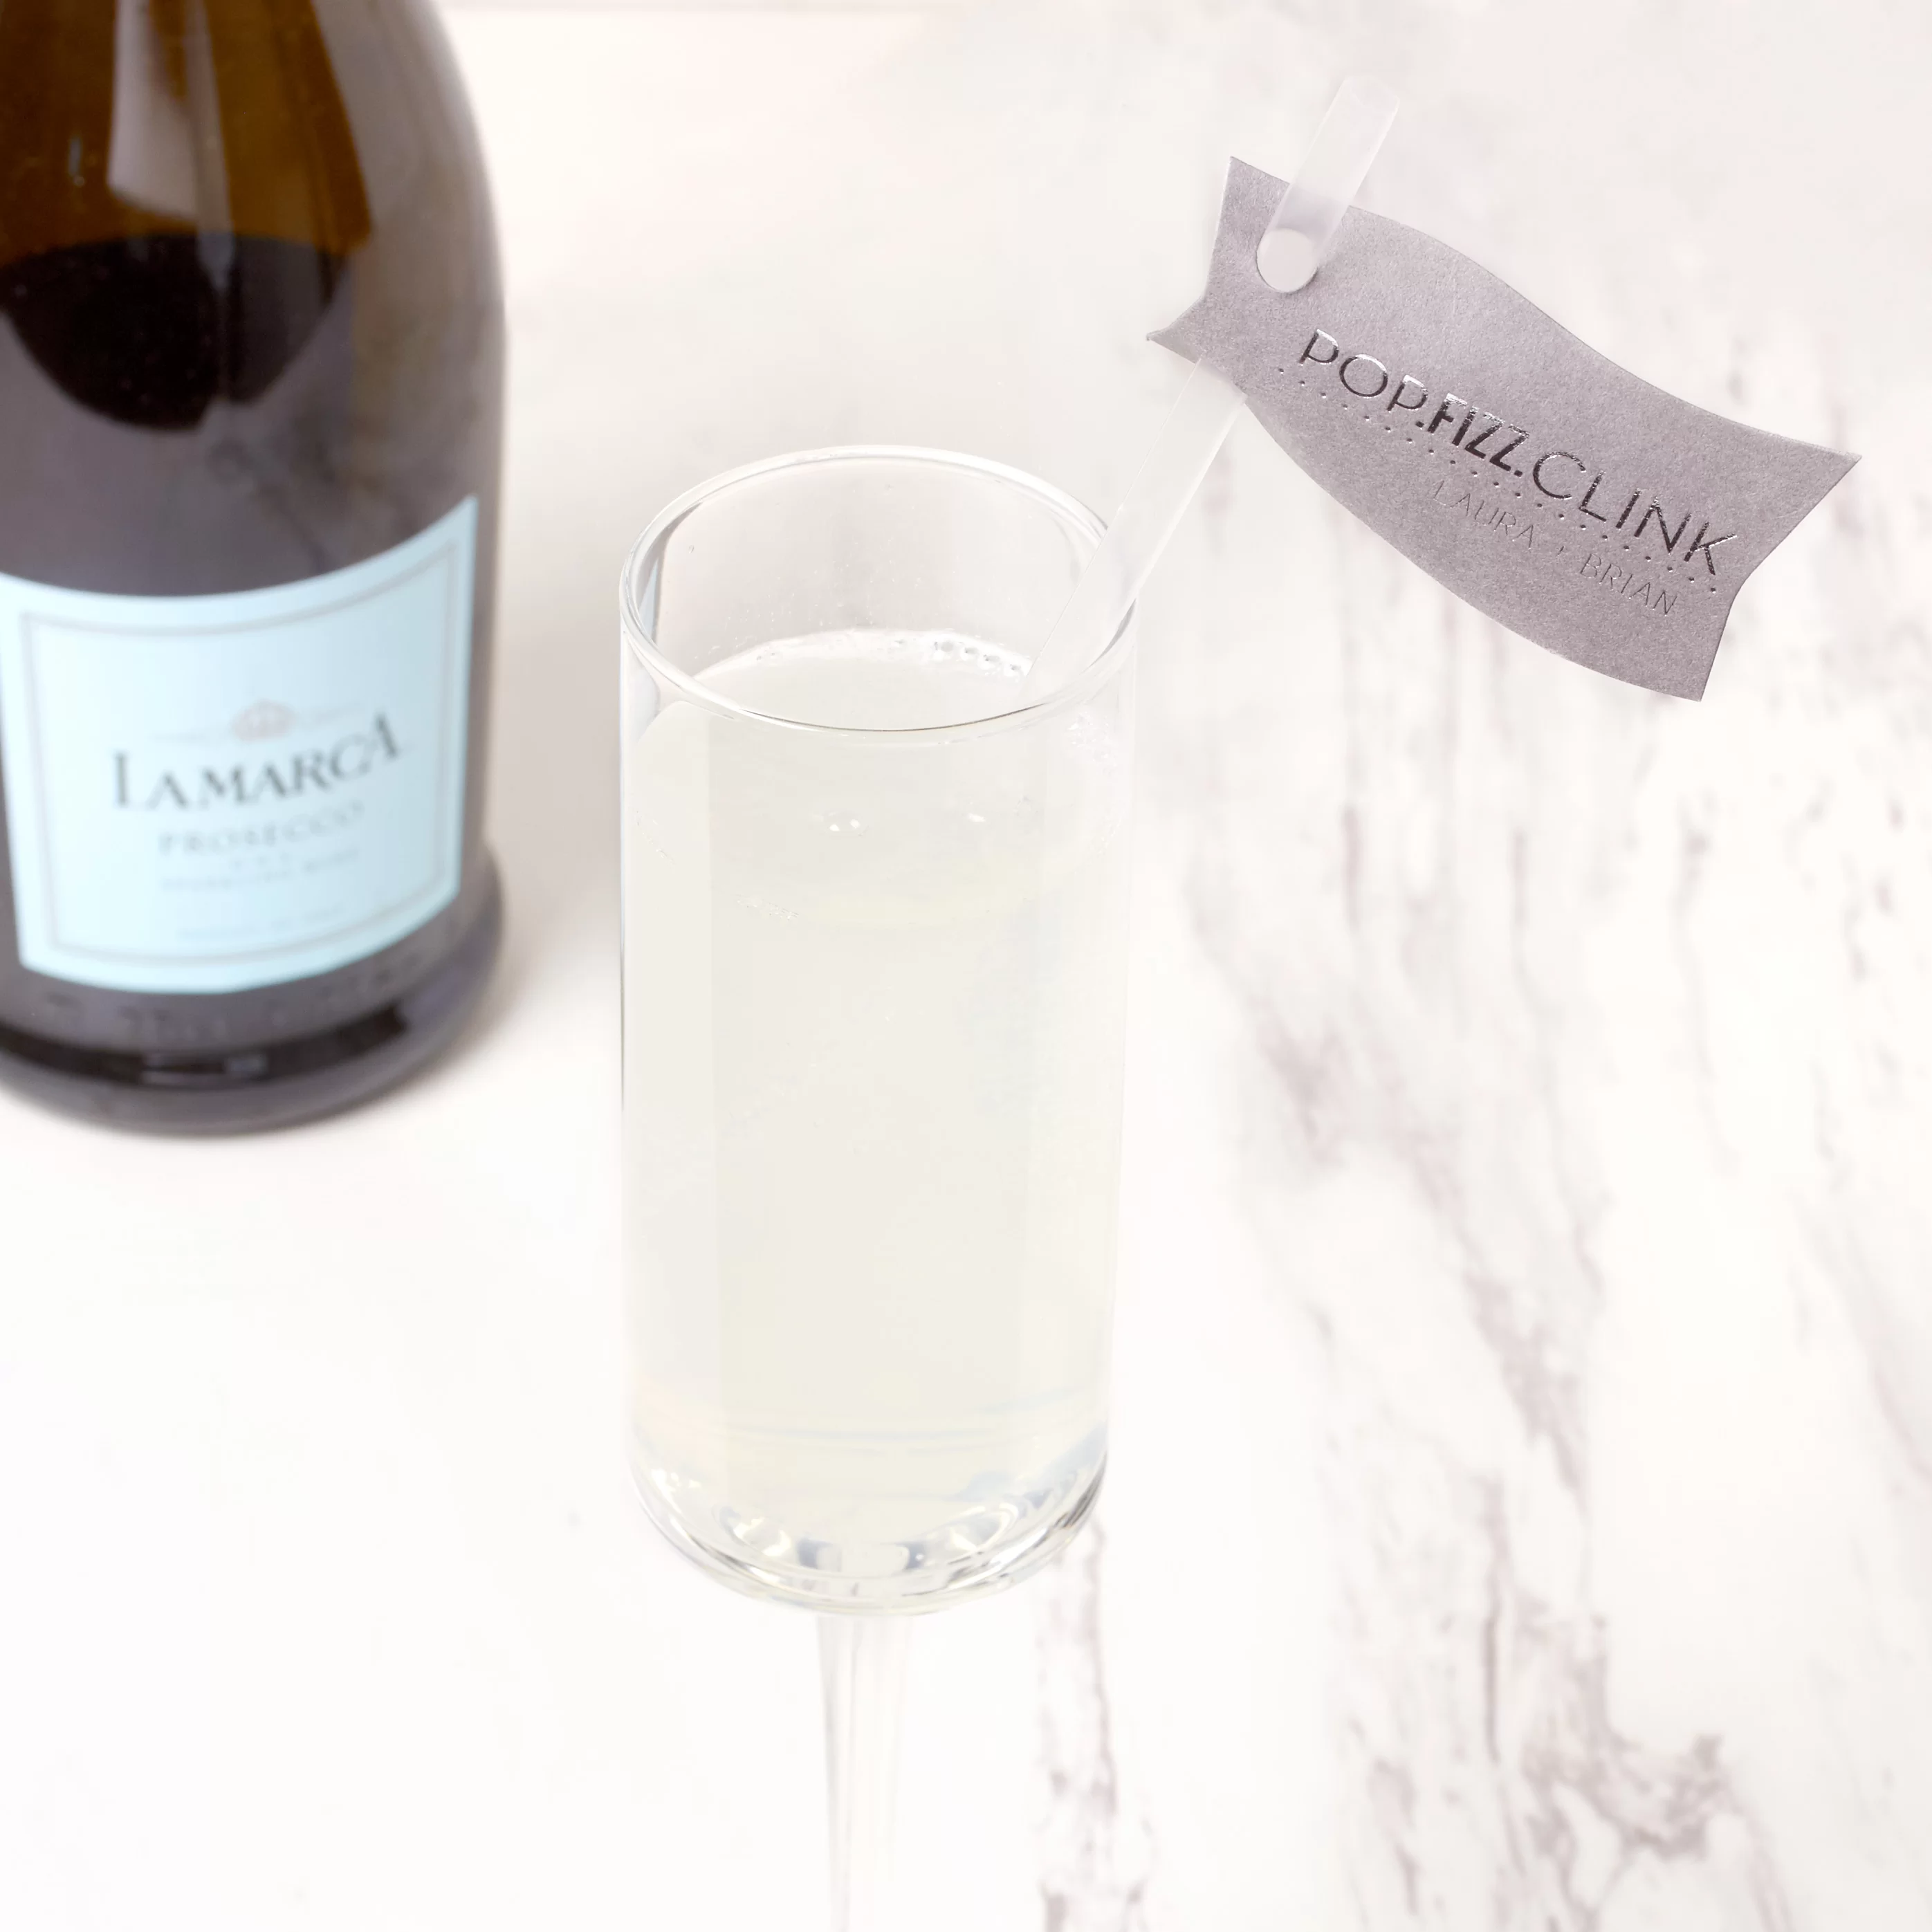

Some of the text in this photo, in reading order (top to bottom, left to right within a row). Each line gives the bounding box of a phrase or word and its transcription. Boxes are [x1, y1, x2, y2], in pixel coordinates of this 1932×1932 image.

[1430, 480, 1534, 549] LAURA
[1579, 553, 1677, 616] BRIAN
[158, 800, 365, 856] PROSECCO
